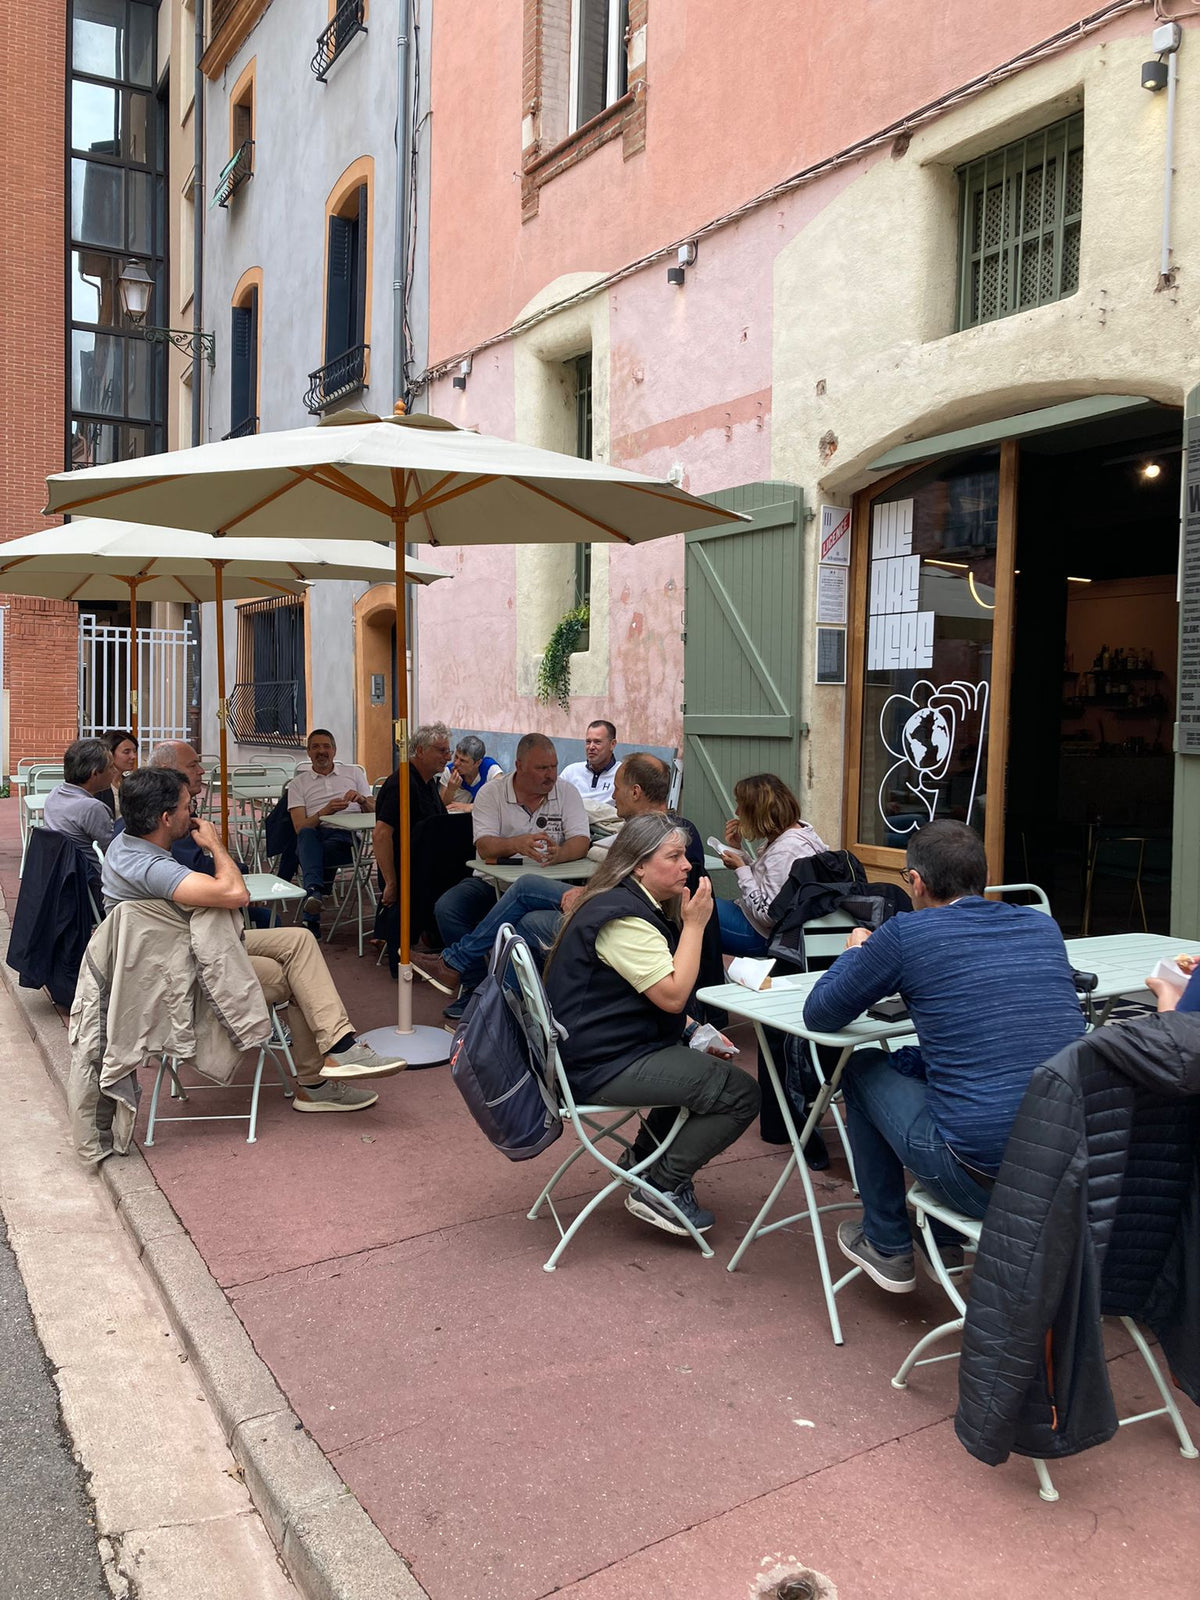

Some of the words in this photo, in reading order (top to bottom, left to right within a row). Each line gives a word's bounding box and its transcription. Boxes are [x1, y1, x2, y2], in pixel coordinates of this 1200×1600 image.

[822, 515, 849, 556] LICENCE
[872, 498, 914, 560] WE
[870, 554, 920, 615] ARE
[867, 611, 934, 671] HERE
[602, 782, 611, 791] H
